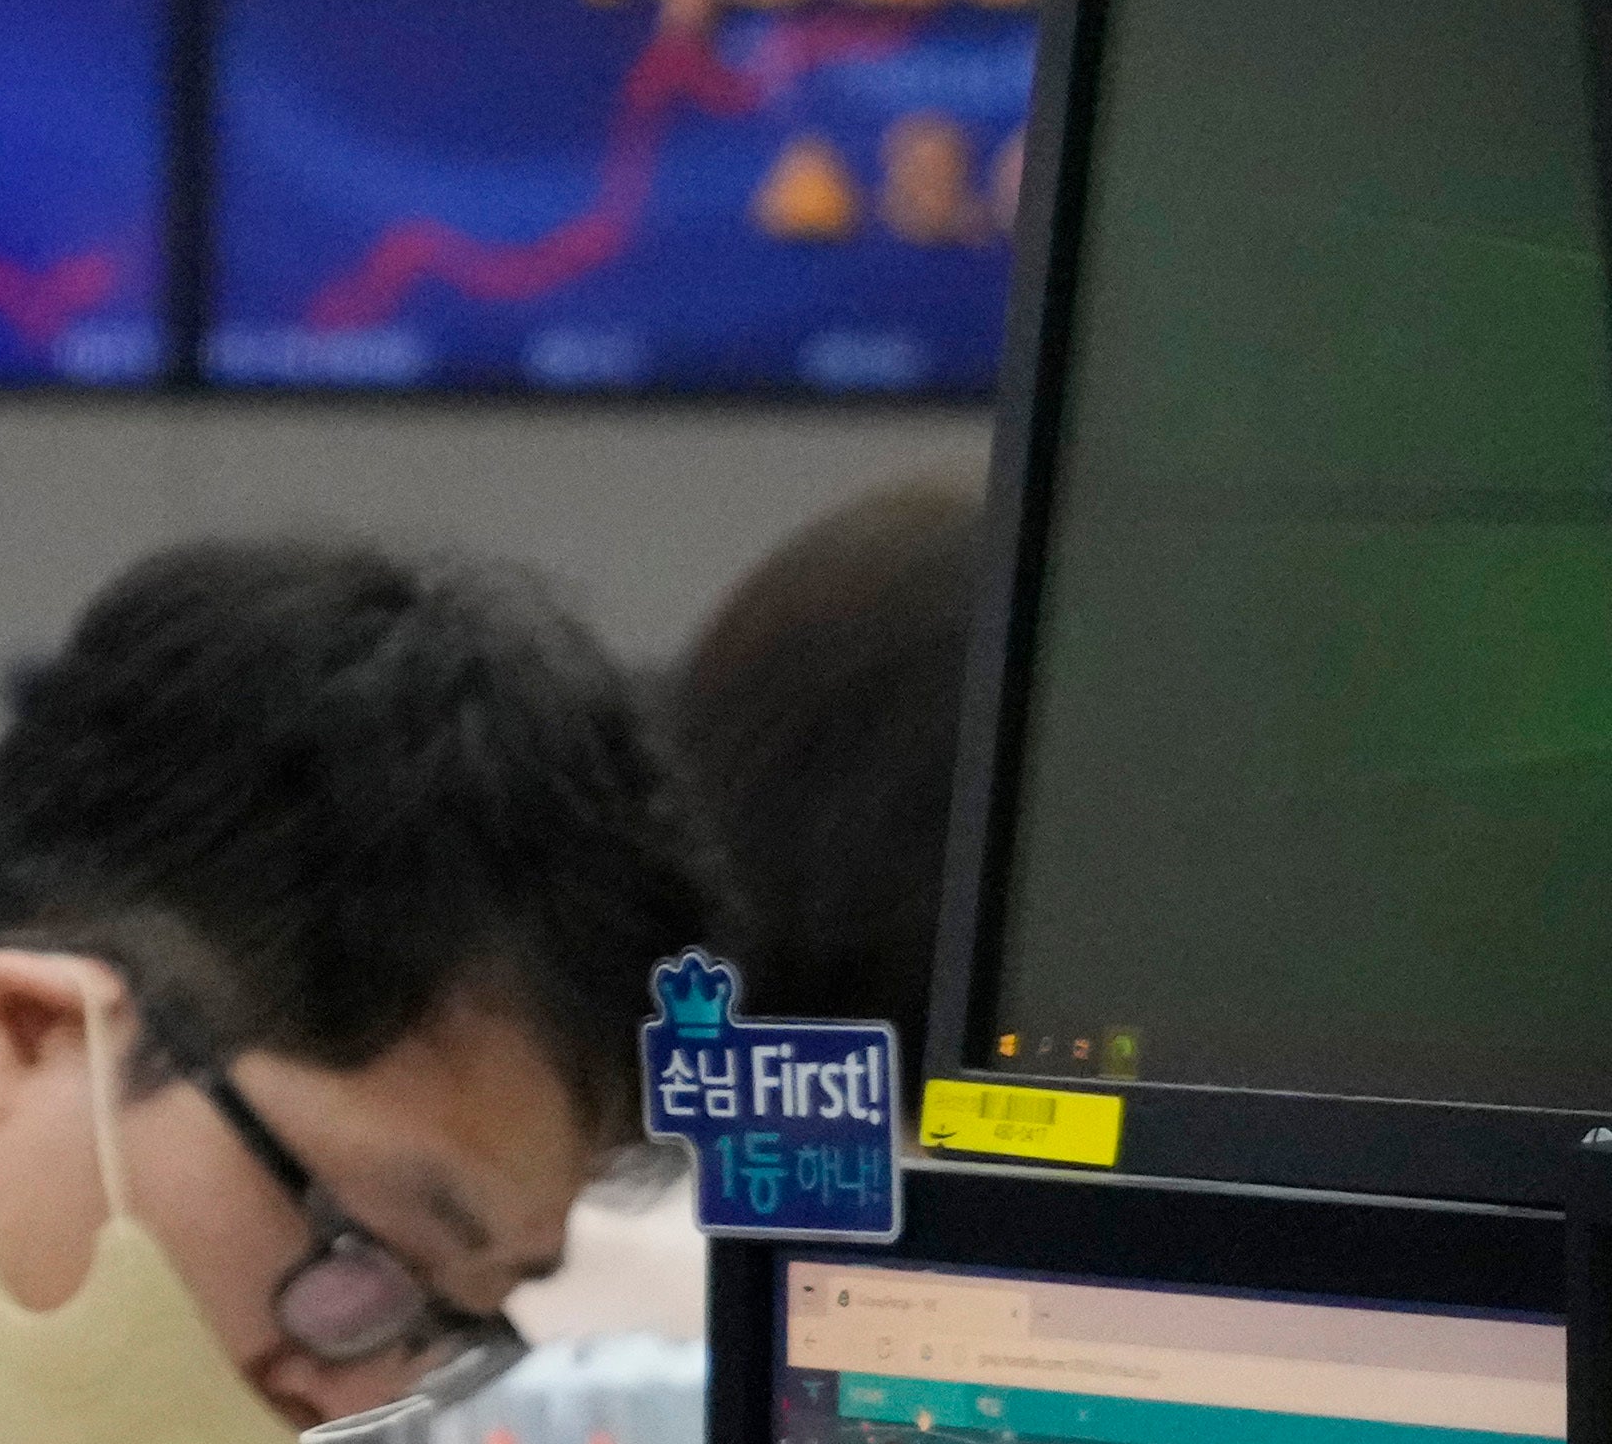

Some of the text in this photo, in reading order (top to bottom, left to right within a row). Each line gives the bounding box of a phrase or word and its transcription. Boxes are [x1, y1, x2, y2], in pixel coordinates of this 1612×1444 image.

[659, 1043, 882, 1125] 손님 First!
[715, 1133, 786, 1215] 1등
